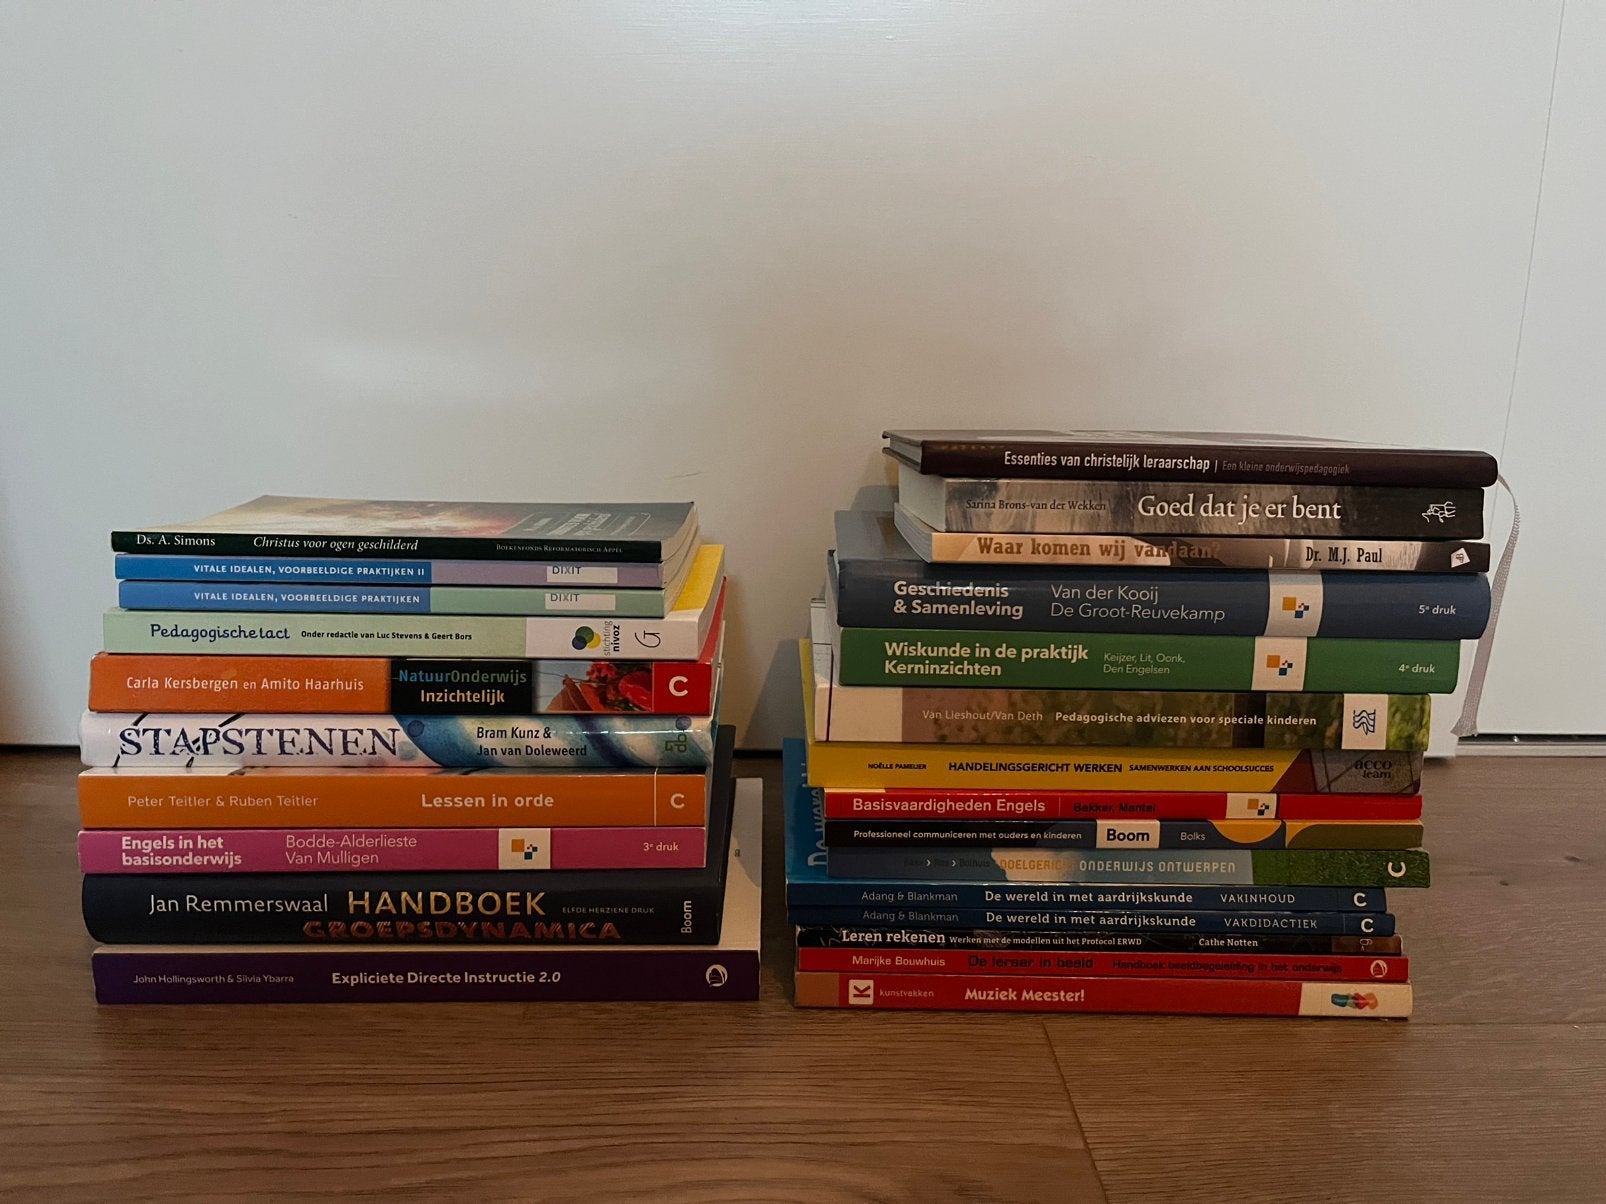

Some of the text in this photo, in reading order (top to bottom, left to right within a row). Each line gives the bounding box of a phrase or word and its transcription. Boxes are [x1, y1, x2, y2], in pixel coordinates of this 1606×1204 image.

[1004, 452, 1057, 466] Essenties
[1061, 456, 1080, 466] van
[1084, 454, 1139, 468] christelijk
[1143, 456, 1210, 473] leraarschap
[1239, 462, 1263, 472] kleine
[966, 500, 1106, 511] Sarina Brons-van der Wekken
[1138, 495, 1342, 525] Goed dat je er bent
[137, 534, 215, 546] Ds. Simons
[253, 537, 418, 552] Christus voor ogen geschilderd
[977, 537, 1126, 561] Waar komen wij
[1306, 547, 1383, 563] Dr. M.J. Paul
[194, 565, 413, 576] VITALE IDEALEN, VOORBEELDIGE PRAKTIJKEN
[552, 566, 581, 575] DIXIT
[894, 581, 1009, 598] Geschiedenis
[1051, 585, 1159, 604] Van der Kooij
[911, 600, 1024, 620] Samenleving
[1051, 603, 1225, 622] De Groot-Reuvekamp
[326, 631, 358, 639] redactie
[376, 631, 389, 639] Luc
[391, 631, 422, 639] Stevens
[603, 620, 612, 656] stichting
[885, 642, 1088, 663] Wiskunde in de praktijk
[1104, 653, 1185, 663] Keijzer, Lit, Oonk,
[884, 661, 1001, 675] Kerninzichten
[1103, 664, 1170, 675] Den Engelsen
[400, 669, 527, 686] NatuurOnderwijs
[127, 677, 364, 692] Carla Kersbergen Amito Haarhuis
[421, 690, 505, 706] Inzichtelijk
[922, 710, 1043, 721] Van Lieshout/Van Deth
[1055, 711, 1317, 727] Pedagogische adviezen voor speciale kinderen
[477, 727, 539, 739] Bram Kunz
[120, 728, 400, 755] STAPSTENEN
[477, 745, 587, 757] Jan van Doleweerd
[949, 762, 1070, 772] HANDELINGSGERICHT
[1073, 763, 1122, 772] WERKEN
[1355, 758, 1392, 770] acco
[1362, 769, 1392, 779] team
[128, 796, 318, 807] Peter Teitler Ruben Teitler
[421, 794, 554, 807] Lessen in orde
[853, 799, 1045, 814] Basisvaardigheden Engels
[286, 835, 417, 848] Bodde-Alderlieste
[854, 831, 911, 840] Professioneel
[913, 831, 977, 839] communiceren
[998, 831, 1028, 839] ouders
[1043, 832, 1082, 840] kinderen
[1180, 832, 1205, 840] Bolks
[121, 836, 224, 852] Engels in het
[121, 852, 242, 867] basisonderwijs
[286, 851, 379, 867] Van Mulligen
[1079, 861, 1235, 873] ONDERWIJS ONTWERPEN
[149, 891, 546, 915] Jan Remmerswaal HANDBOEK
[861, 892, 958, 903] Adang Blankman
[985, 891, 1192, 905] De wereld met aardrijkskunde
[1220, 894, 1295, 904] VAKINHOUD
[681, 900, 692, 933] Boom
[1224, 918, 1318, 928] VAKDIDACTIEK
[303, 923, 621, 939] GROEPSDYNAMICA
[842, 931, 946, 943] Leren rekenen
[1013, 937, 1051, 945] modellen
[1199, 938, 1258, 947] Cathe Notten
[852, 956, 945, 967] Marijke Bouwhuis
[133, 974, 294, 985] John Hollingsworth Silvia Ybarra
[332, 972, 561, 986] Expliciete Directe Instructie 2.0
[880, 989, 934, 997] kunstvakken
[964, 989, 1085, 1002] Muziek Meester!
